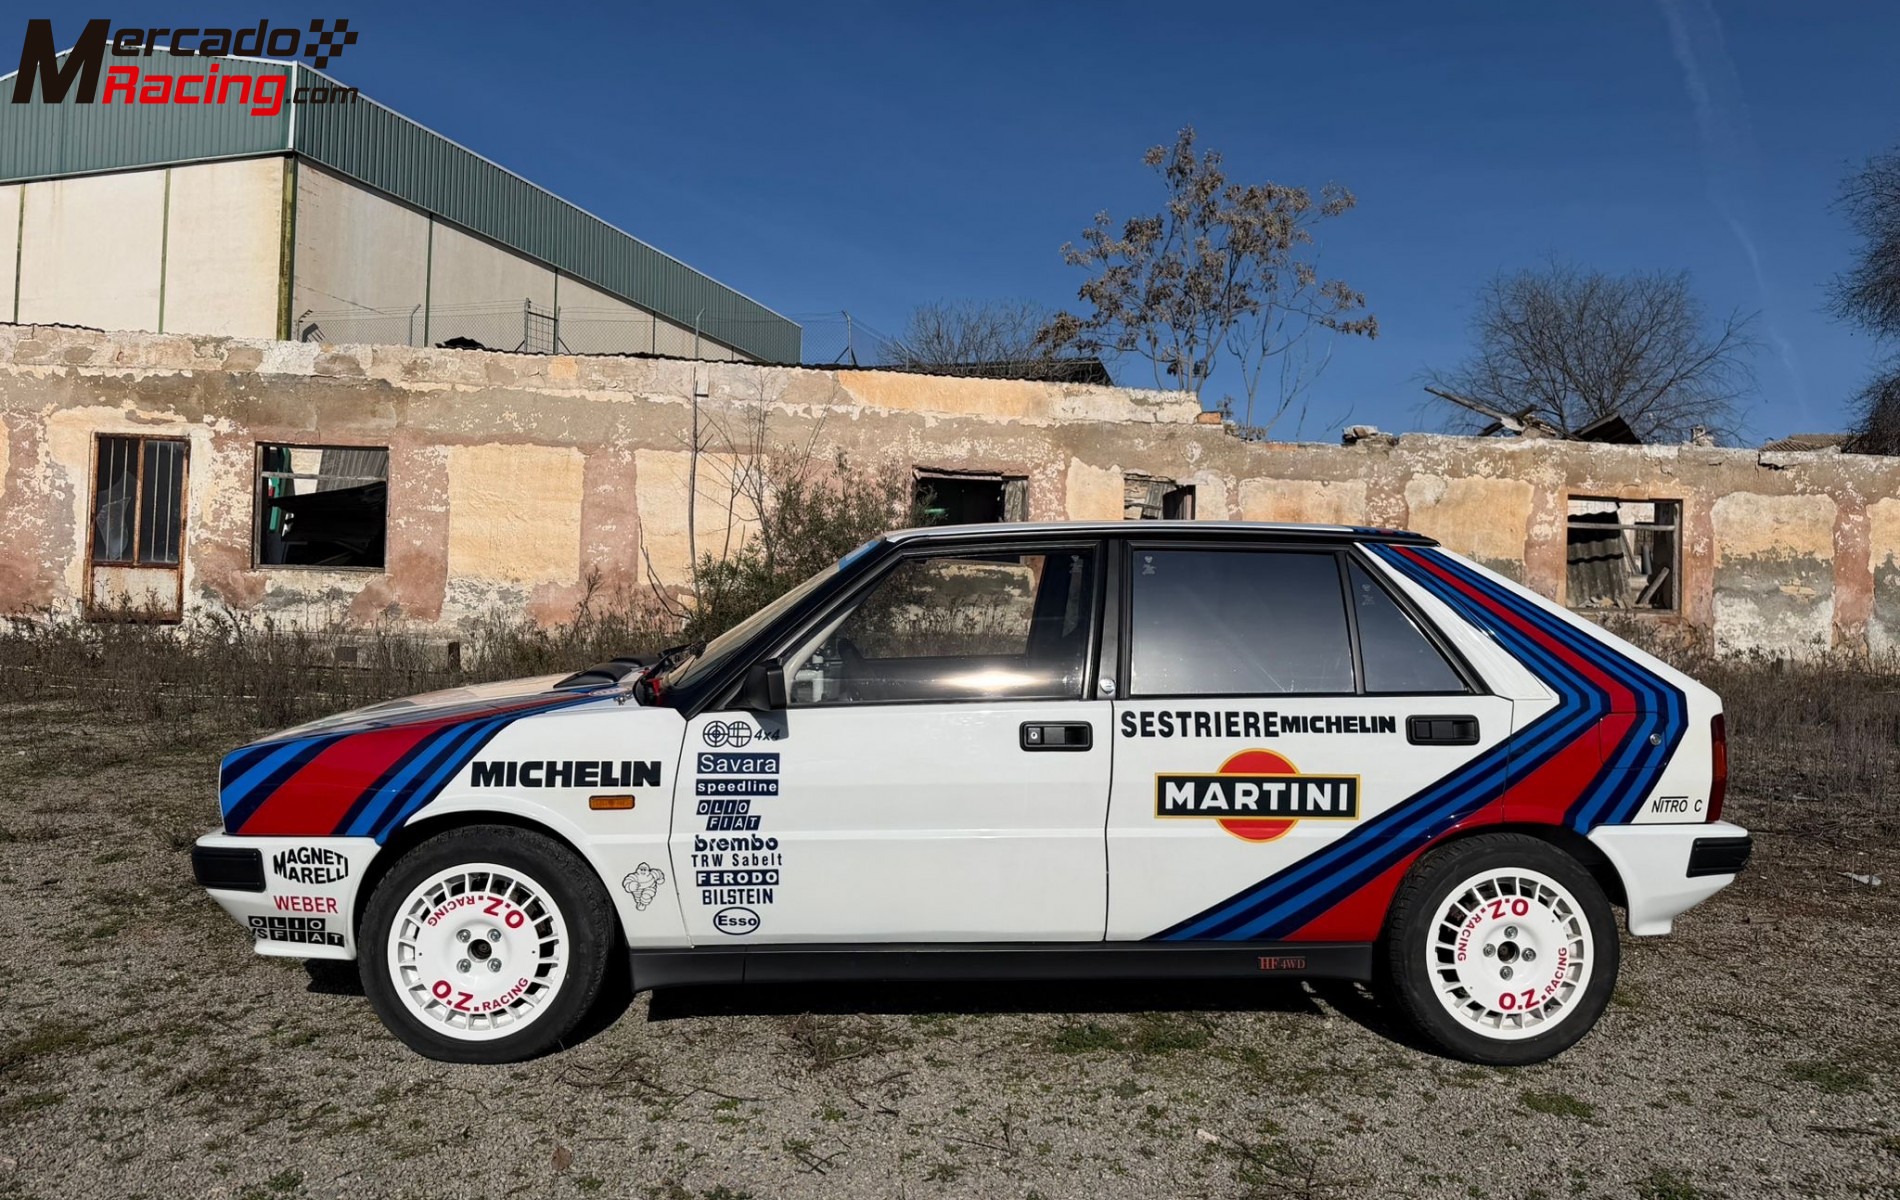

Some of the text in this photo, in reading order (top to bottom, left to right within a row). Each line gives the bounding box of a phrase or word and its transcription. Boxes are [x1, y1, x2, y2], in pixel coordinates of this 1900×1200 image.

[1121, 710, 1397, 738] SESTRIERE MICHELIN
[754, 729, 780, 741] 4x4
[700, 754, 777, 772] Savara
[470, 761, 662, 788] MICHELIN
[698, 780, 777, 794] speedline
[1165, 781, 1348, 811] MARTINI
[699, 802, 748, 813] OLIO
[1651, 797, 1703, 813] NITRO C
[709, 817, 758, 828] FIAT
[695, 833, 778, 852] brembo
[273, 847, 349, 870] MAGNETI
[691, 852, 782, 867] TRW Sabelt
[273, 862, 349, 884] MARELLI
[697, 871, 778, 884] FERODO
[273, 896, 338, 913] WEBER
[702, 888, 774, 905] BILSTEIN
[427, 895, 476, 927] RACING
[250, 917, 322, 930] OLIO
[717, 915, 758, 926] Esso
[274, 931, 341, 945] FIAT
[1457, 913, 1482, 961] RACING
[1280, 958, 1306, 969] 4WD
[1544, 947, 1567, 995] RACING
[482, 977, 528, 1011] RACING
